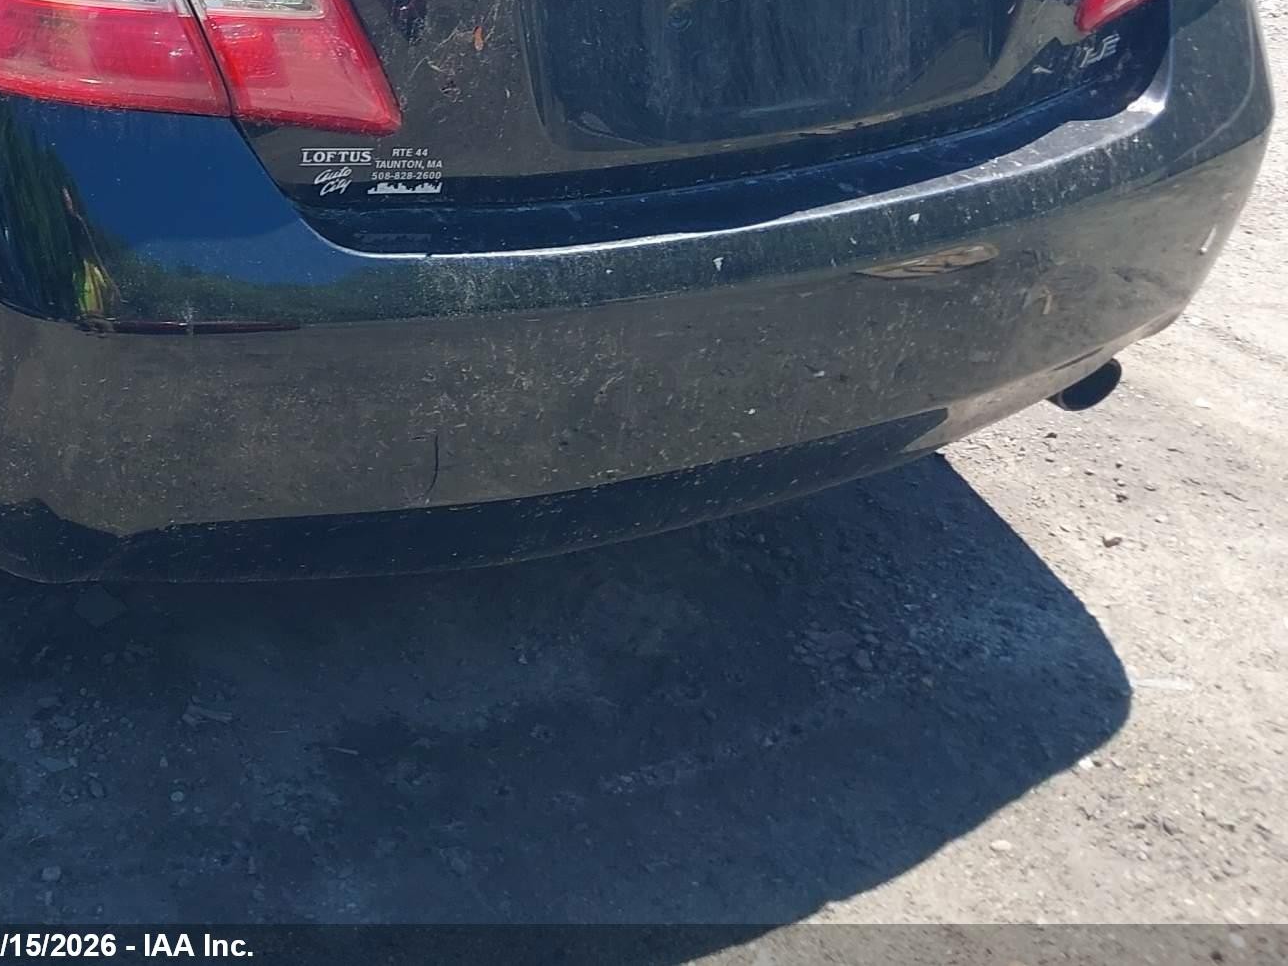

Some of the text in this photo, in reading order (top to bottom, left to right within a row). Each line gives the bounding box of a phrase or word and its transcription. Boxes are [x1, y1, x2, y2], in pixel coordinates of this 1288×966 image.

[302, 151, 372, 163] LOFTUS
[392, 148, 429, 157] RTE 44
[375, 160, 443, 170] TAUNTON, MA
[314, 166, 353, 184] Auto
[372, 171, 443, 180] 508-828-2600
[319, 179, 353, 196] City
